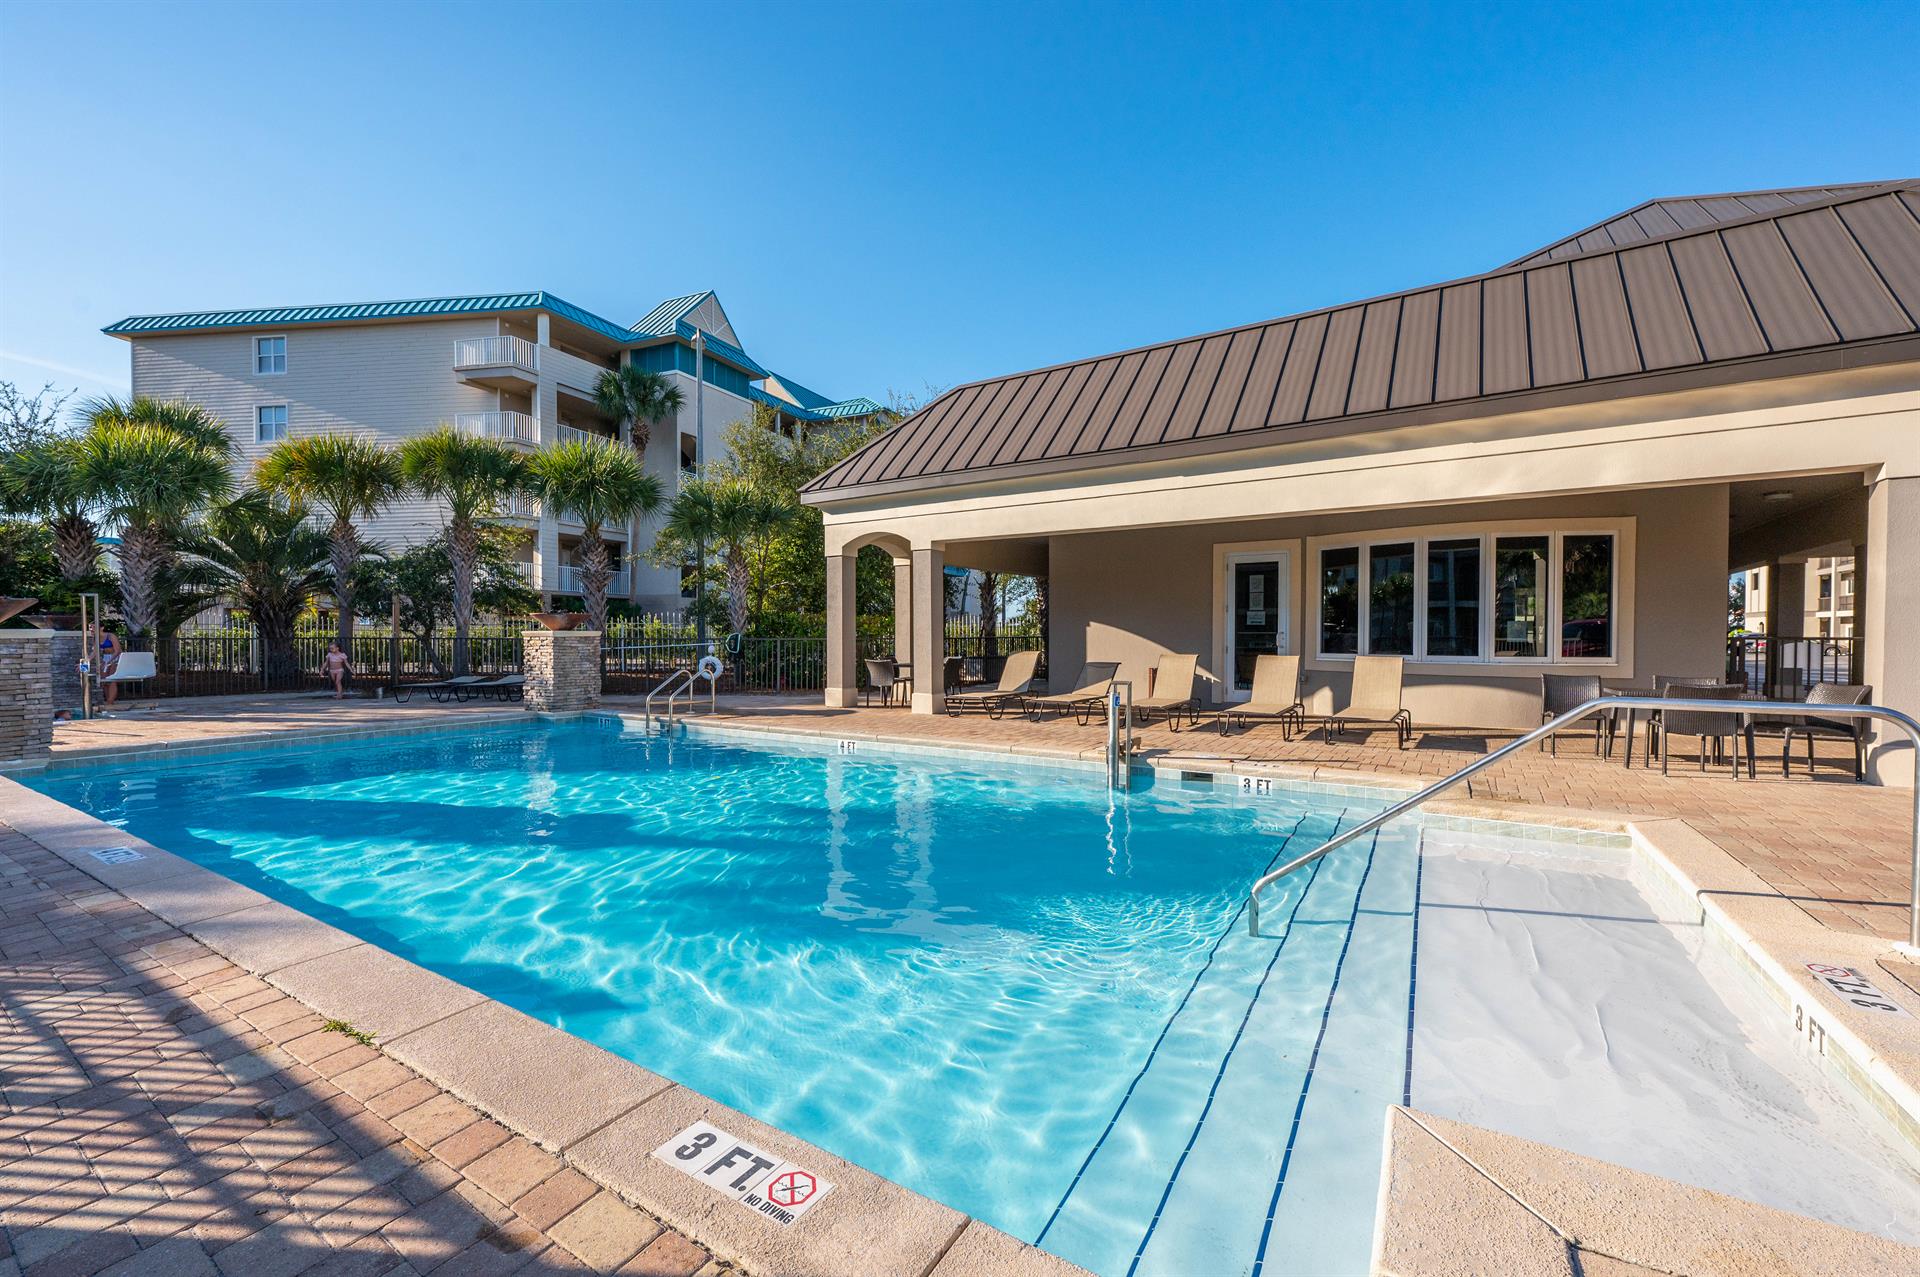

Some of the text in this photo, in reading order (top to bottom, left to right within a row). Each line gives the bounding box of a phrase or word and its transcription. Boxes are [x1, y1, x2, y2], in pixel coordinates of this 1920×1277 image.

[1244, 778, 1271, 790] 3 FT
[1795, 1004, 1803, 1032] 3
[1850, 998, 1898, 1012] 3
[675, 1132, 775, 1192] 3 FT.
[744, 1193, 796, 1225] NO DIVING
